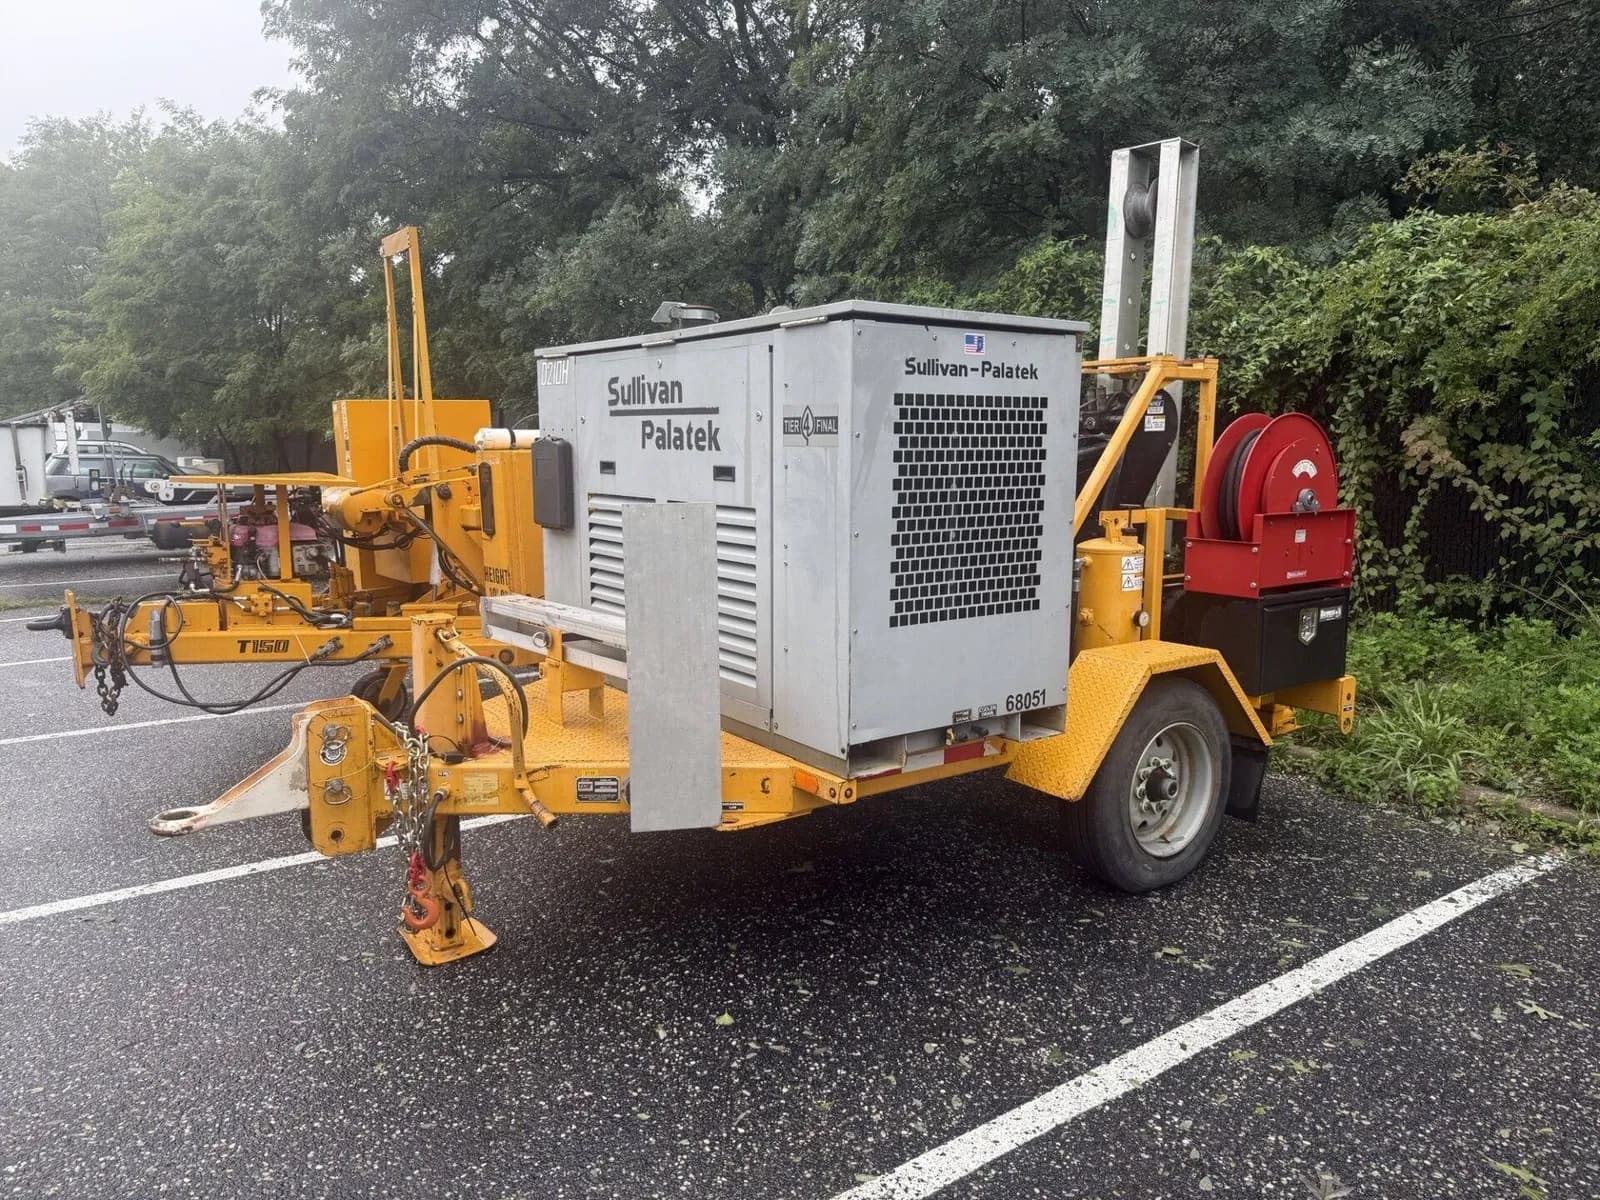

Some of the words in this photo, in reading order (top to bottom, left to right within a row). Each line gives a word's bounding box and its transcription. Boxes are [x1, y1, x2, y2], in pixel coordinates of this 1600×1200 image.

[608, 374, 683, 407] Sullivan
[641, 419, 721, 451] Palatek
[784, 420, 800, 432] TIER
[816, 419, 837, 432] FINAL
[237, 639, 289, 653] T150
[1005, 688, 1047, 712] 68051
